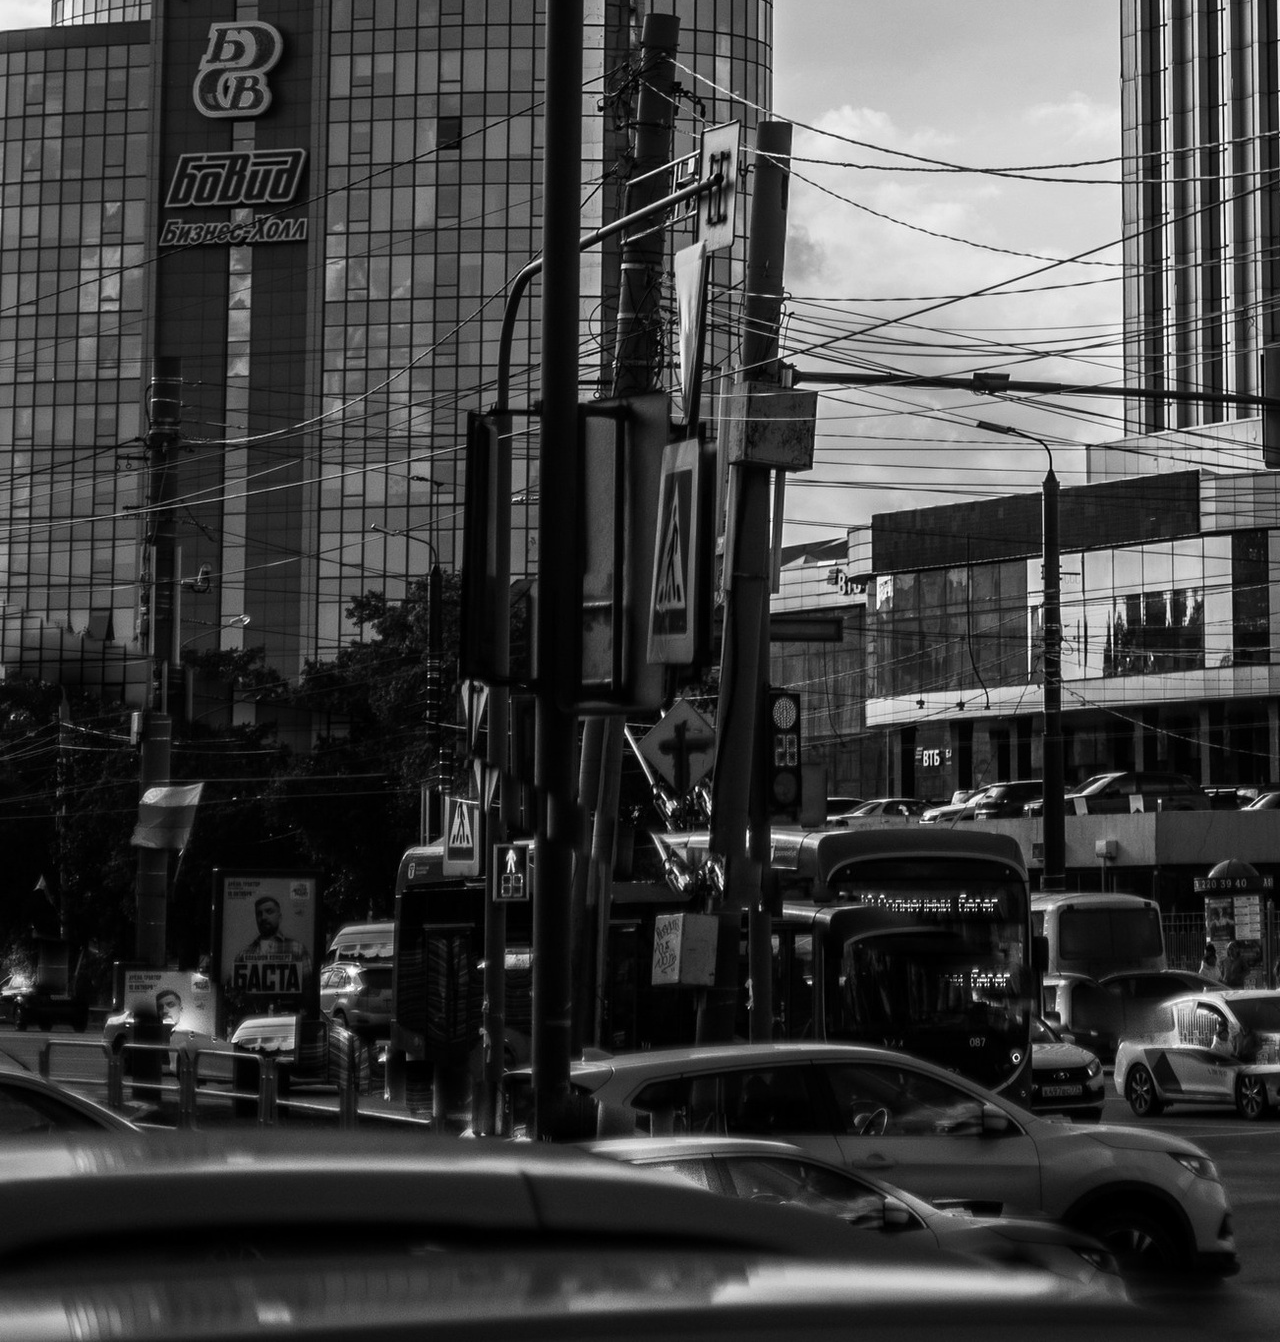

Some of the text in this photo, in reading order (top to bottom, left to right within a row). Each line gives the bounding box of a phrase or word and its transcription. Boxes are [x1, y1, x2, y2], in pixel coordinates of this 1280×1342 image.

[923, 749, 940, 766] ВТБ
[1235, 878, 1247, 888] 40
[234, 963, 301, 992] БАСТА
[969, 1037, 986, 1048] 087
